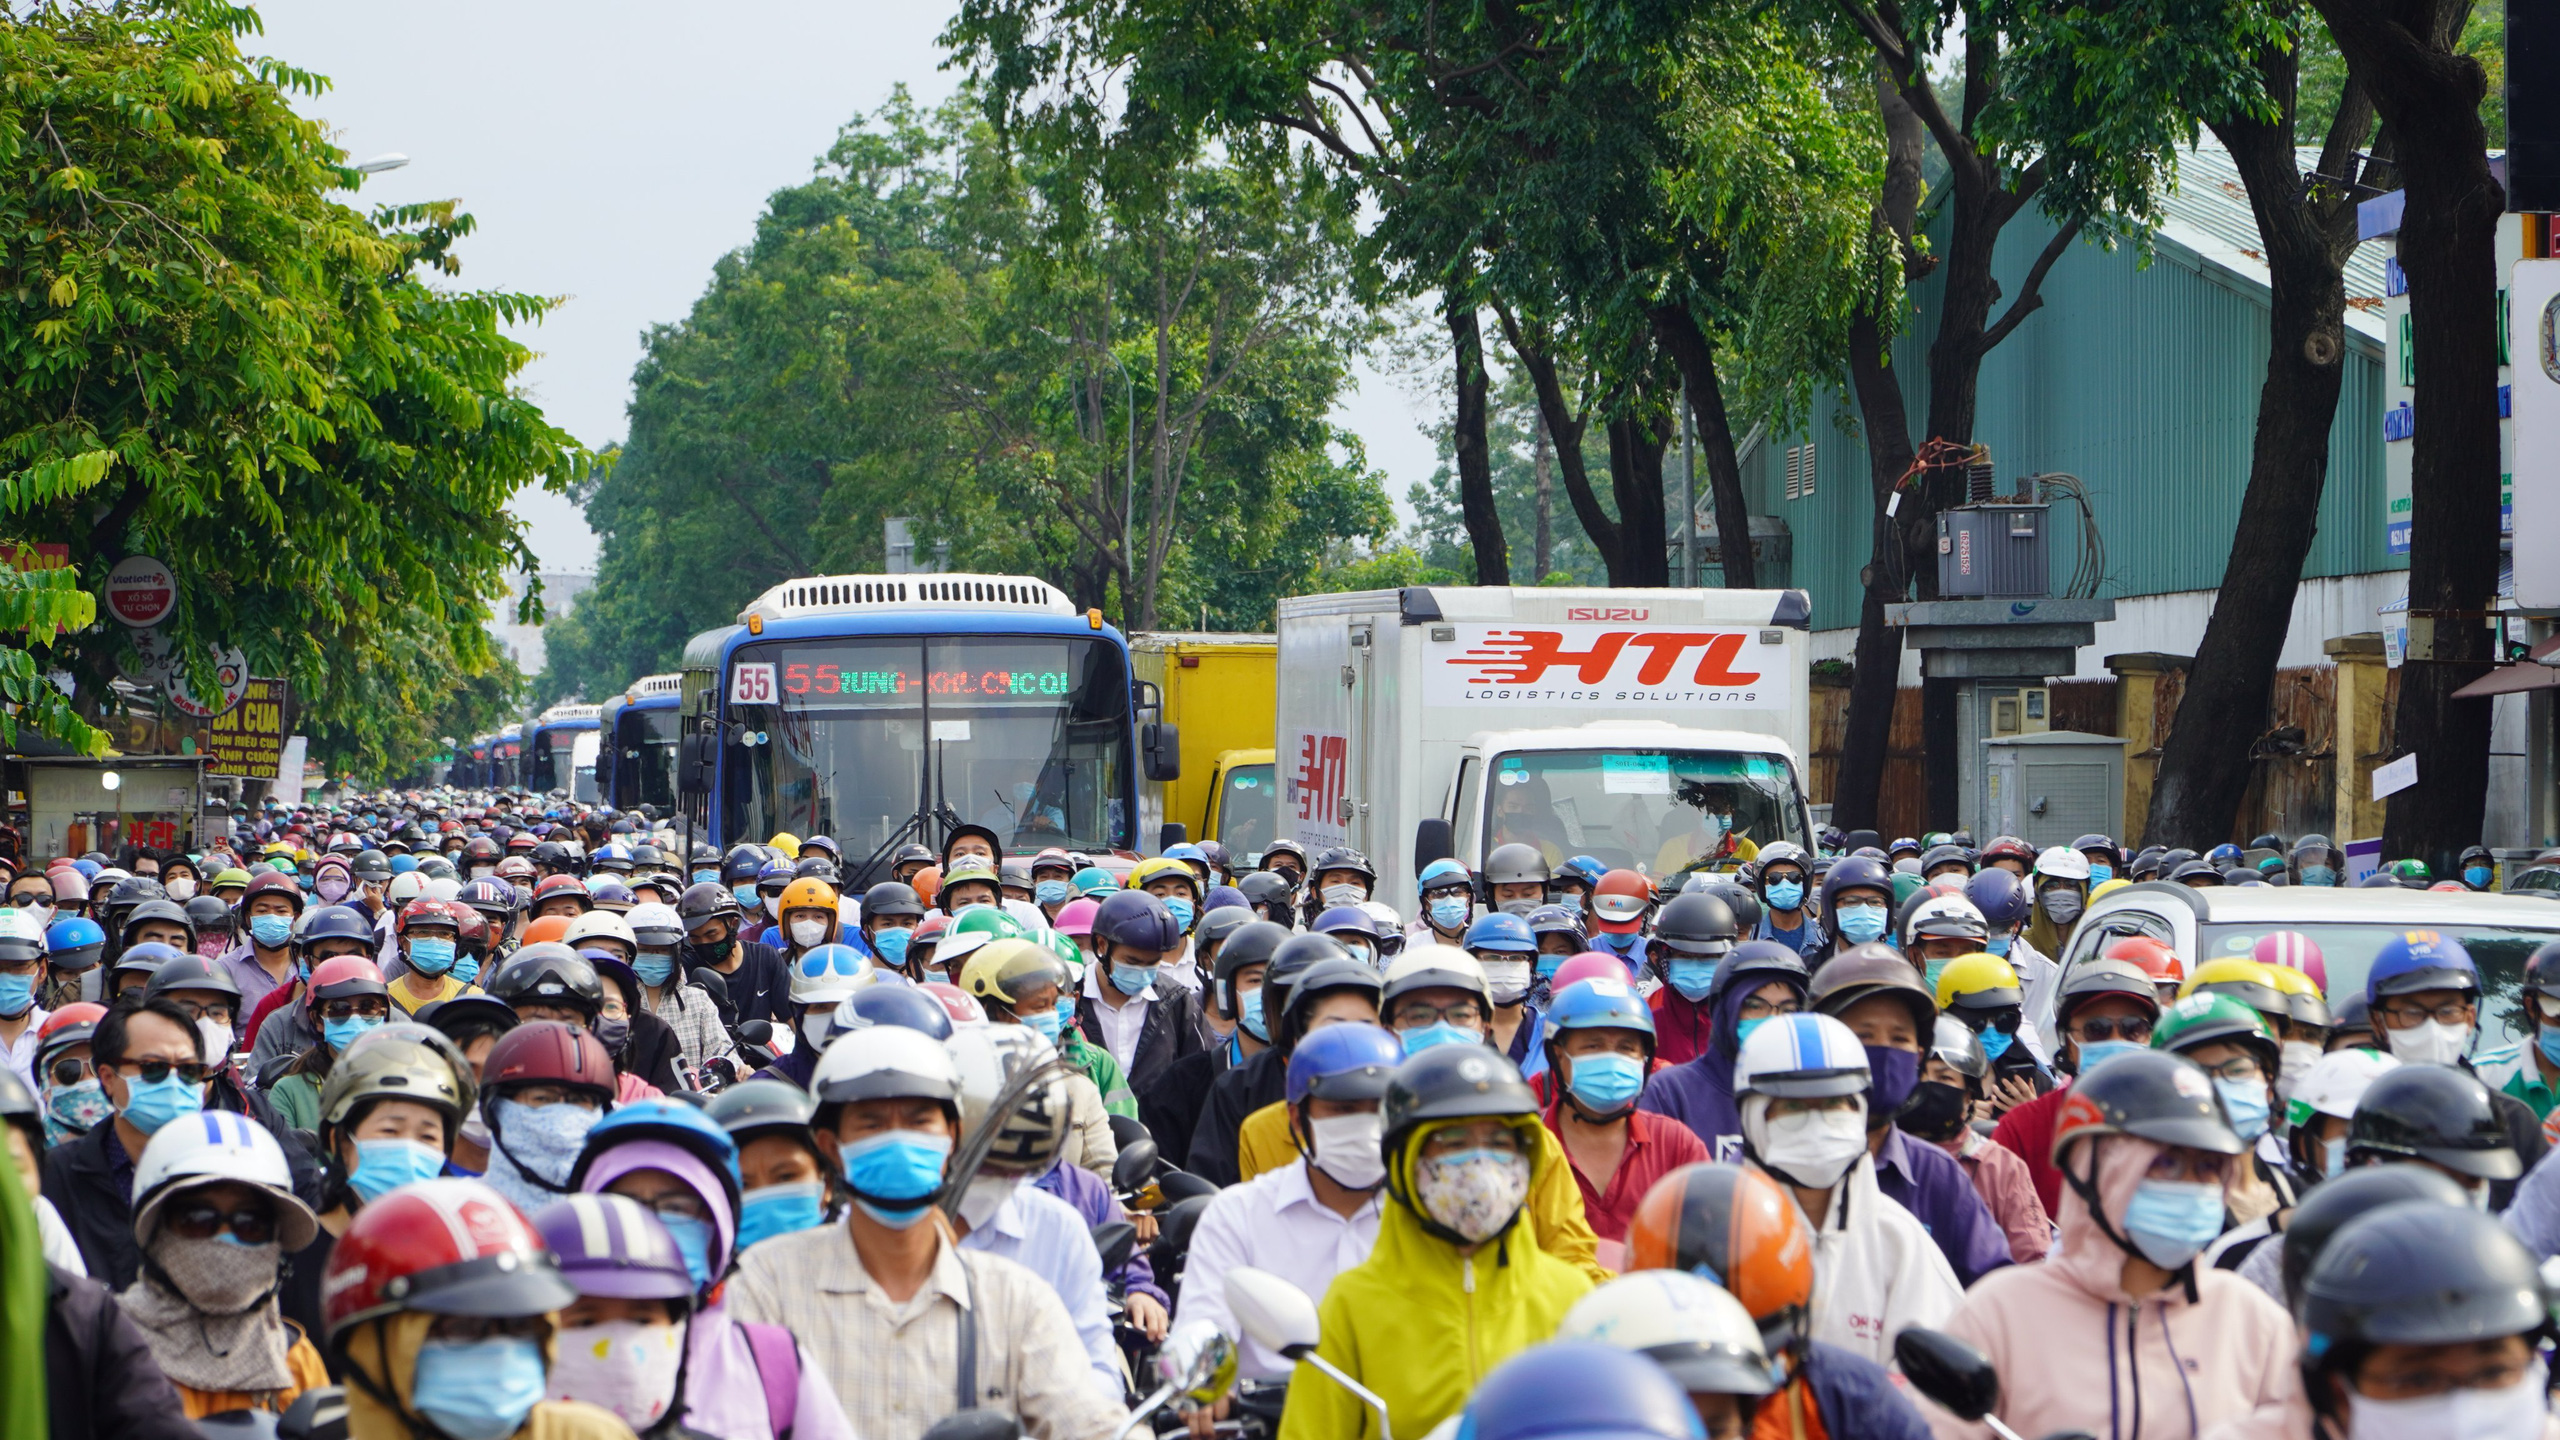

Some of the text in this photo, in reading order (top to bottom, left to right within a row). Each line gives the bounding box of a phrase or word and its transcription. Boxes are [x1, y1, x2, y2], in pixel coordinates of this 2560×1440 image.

[113, 575, 152, 584] Vietlott
[1568, 608, 1649, 621] ISUZU
[1446, 631, 1761, 686] HTL
[738, 667, 771, 700] 55
[784, 664, 841, 694] 55
[1465, 690, 1757, 702] LOGISTICS SOLUTIONS
[243, 702, 280, 734] CUA
[211, 733, 279, 749] BÚN RIÊU CUA
